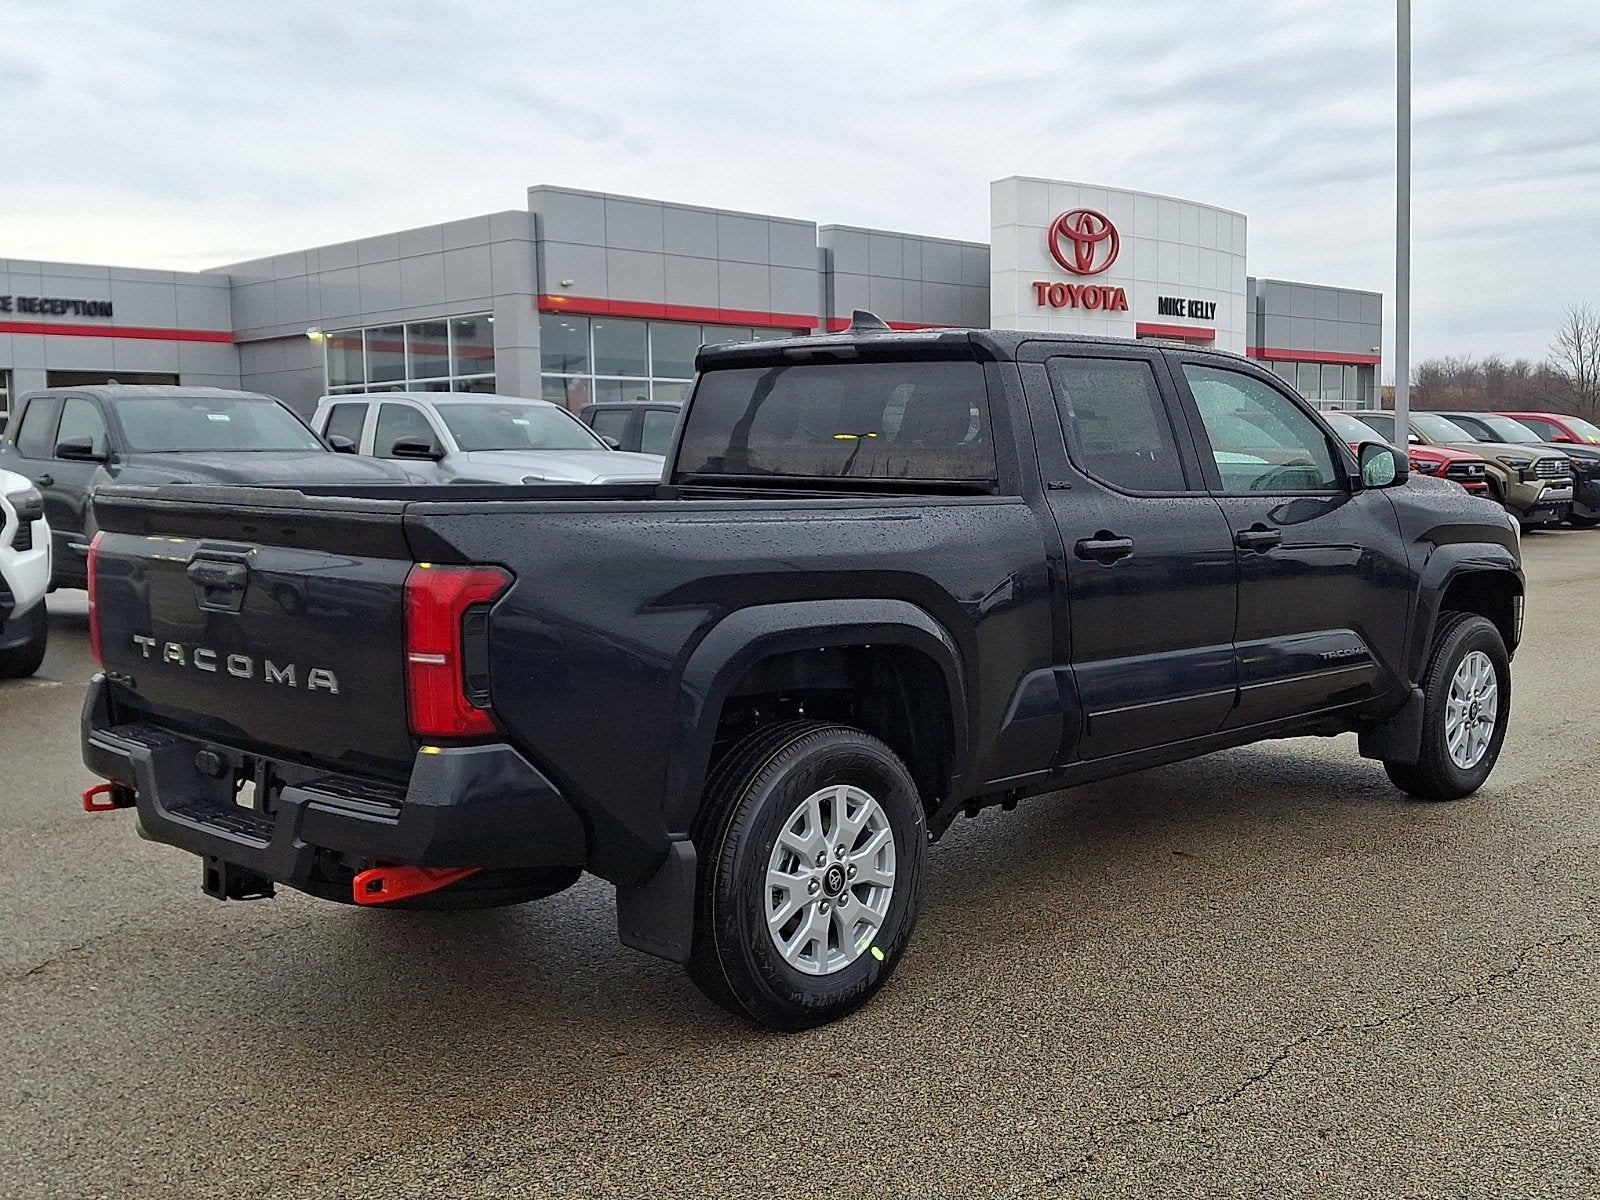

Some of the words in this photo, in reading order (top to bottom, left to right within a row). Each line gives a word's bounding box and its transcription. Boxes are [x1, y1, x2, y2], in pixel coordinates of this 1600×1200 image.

[17, 296, 113, 316] RECEPTION
[1033, 281, 1129, 311] TOYOTA
[1158, 296, 1186, 318] MIKE
[1187, 299, 1217, 320] KELLY
[132, 634, 340, 694] TACOMA
[1320, 646, 1369, 660] TACOMA
